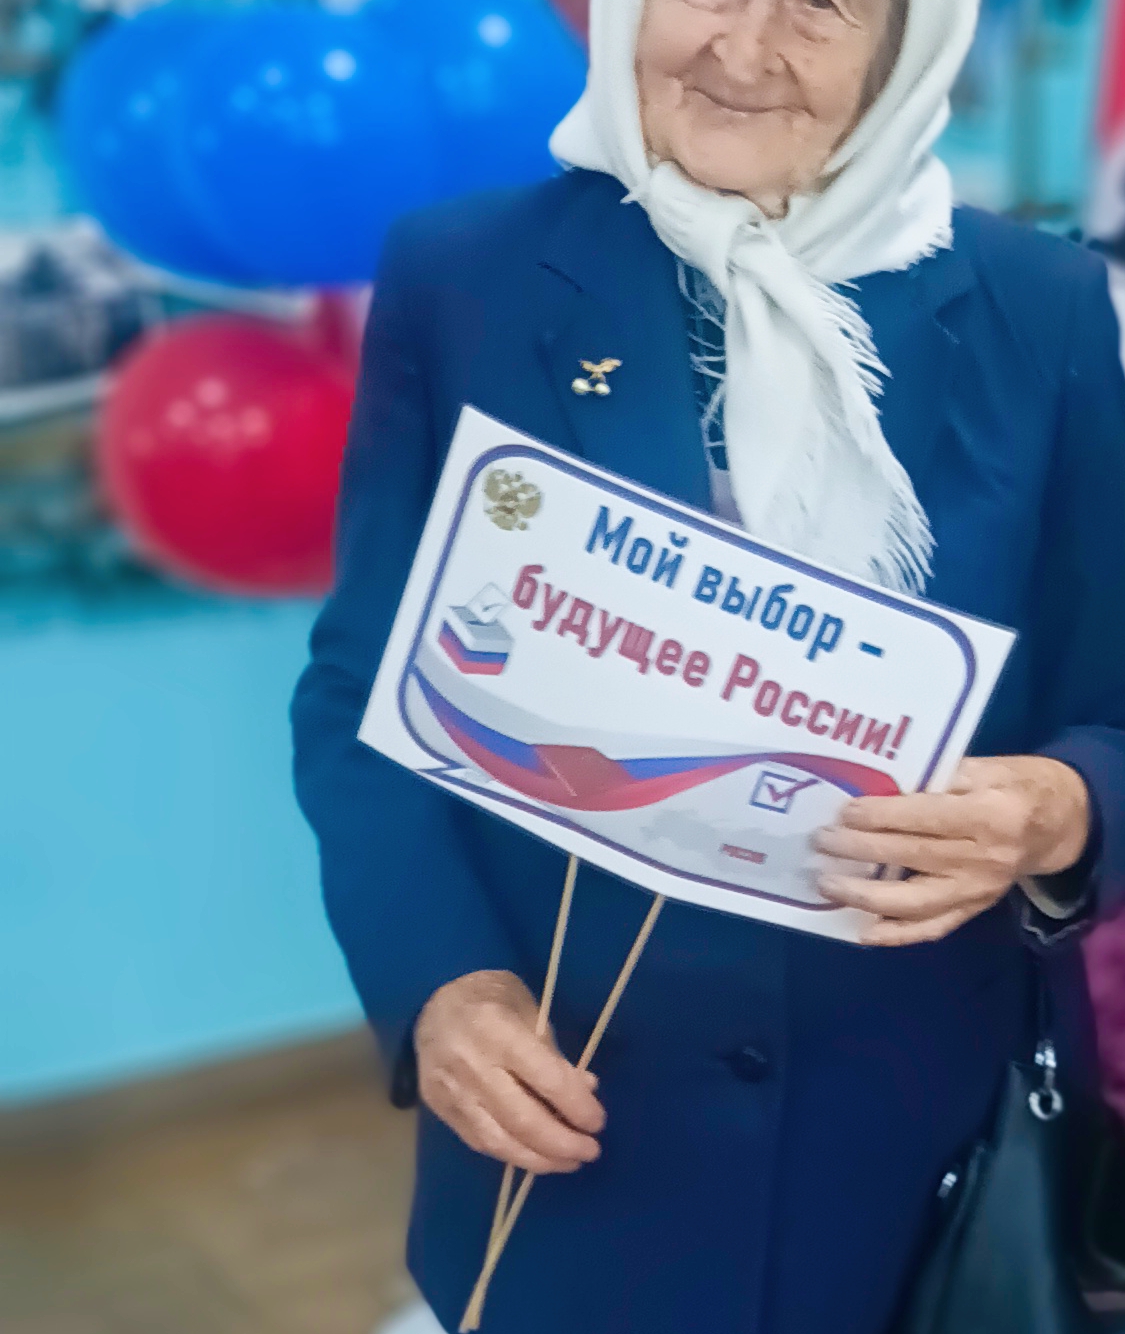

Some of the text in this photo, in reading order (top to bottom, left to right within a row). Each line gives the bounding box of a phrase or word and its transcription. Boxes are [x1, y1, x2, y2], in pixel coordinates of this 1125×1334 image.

[511, 563, 913, 761] будущее России!
[585, 505, 689, 589] Мой
[693, 564, 845, 661] выбор
